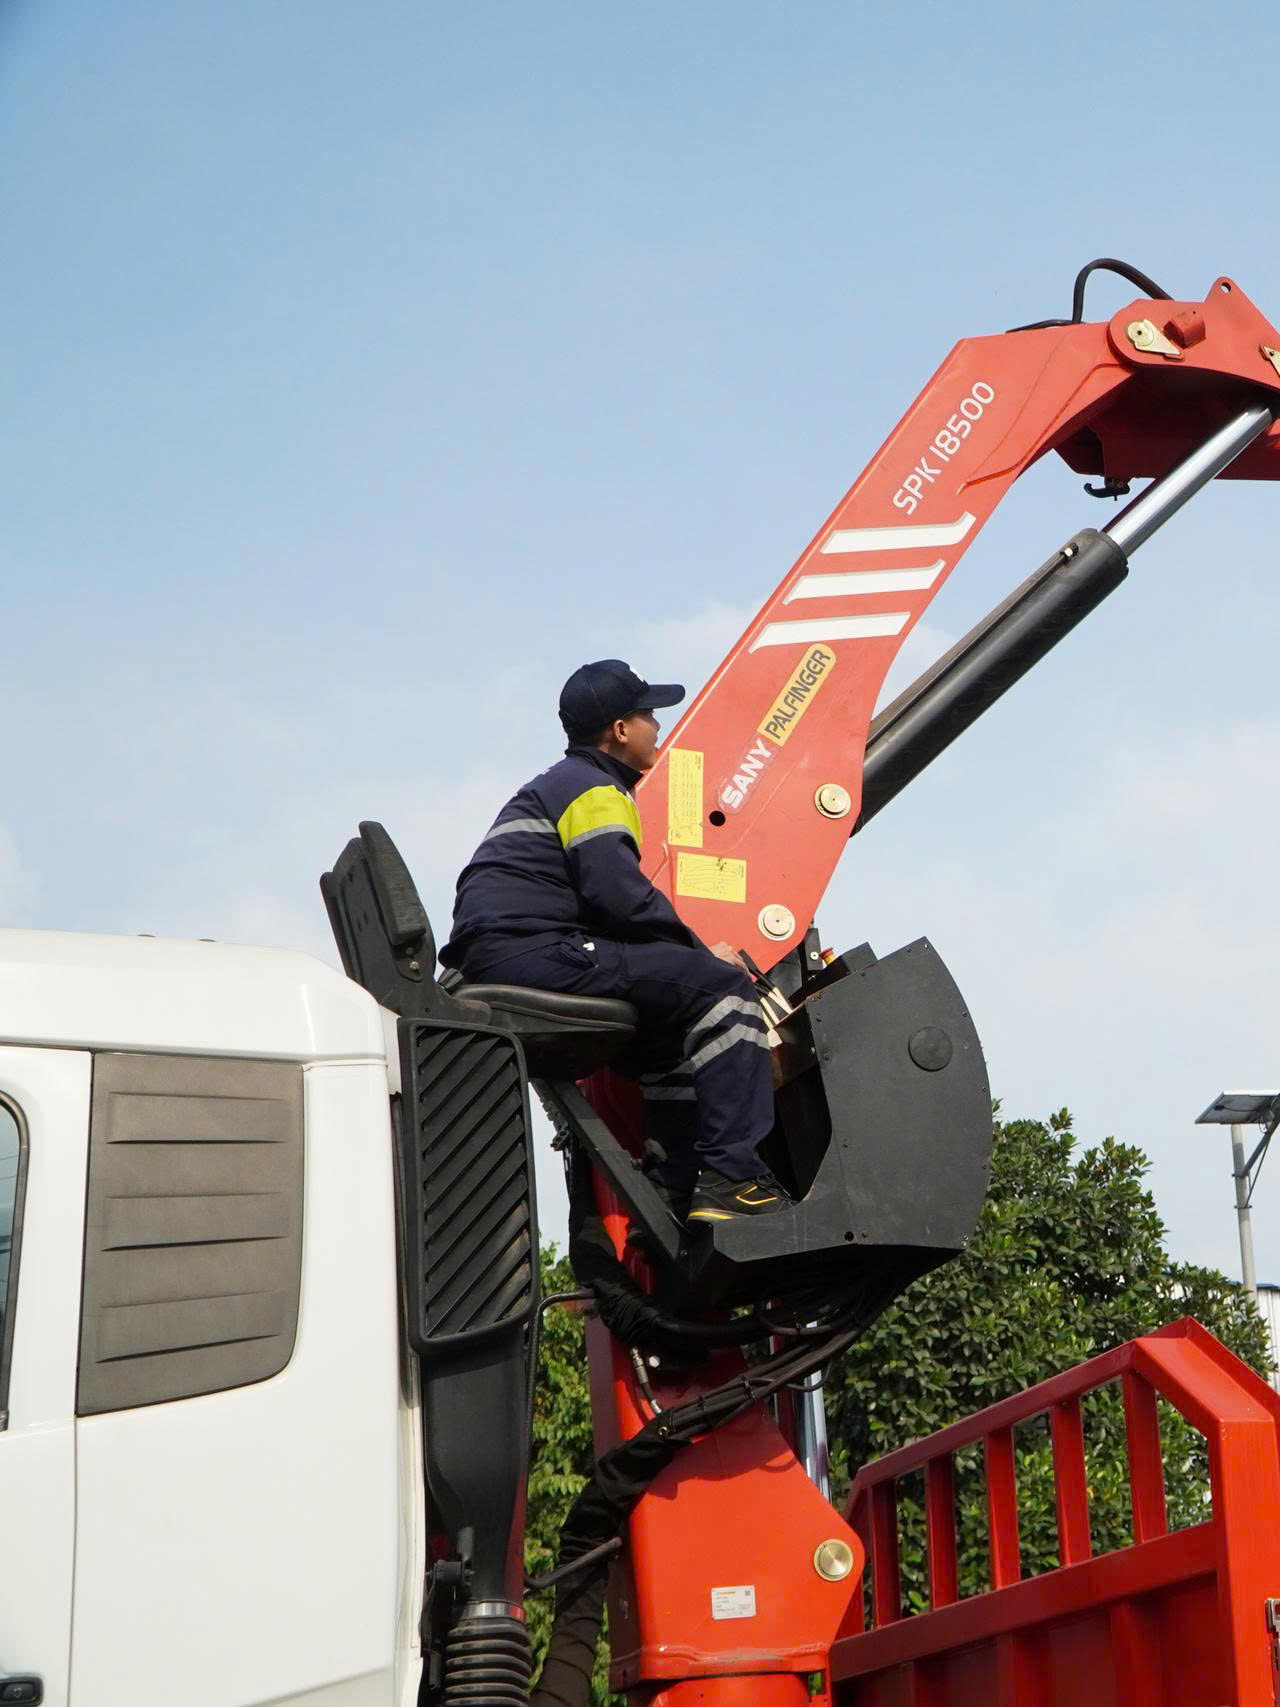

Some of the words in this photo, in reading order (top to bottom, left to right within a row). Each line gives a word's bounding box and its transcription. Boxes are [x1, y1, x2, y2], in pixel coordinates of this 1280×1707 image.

[892, 456, 942, 516] SPK
[928, 381, 995, 463] 18500
[721, 738, 773, 809] SANY
[764, 649, 832, 740] PALFINGER
